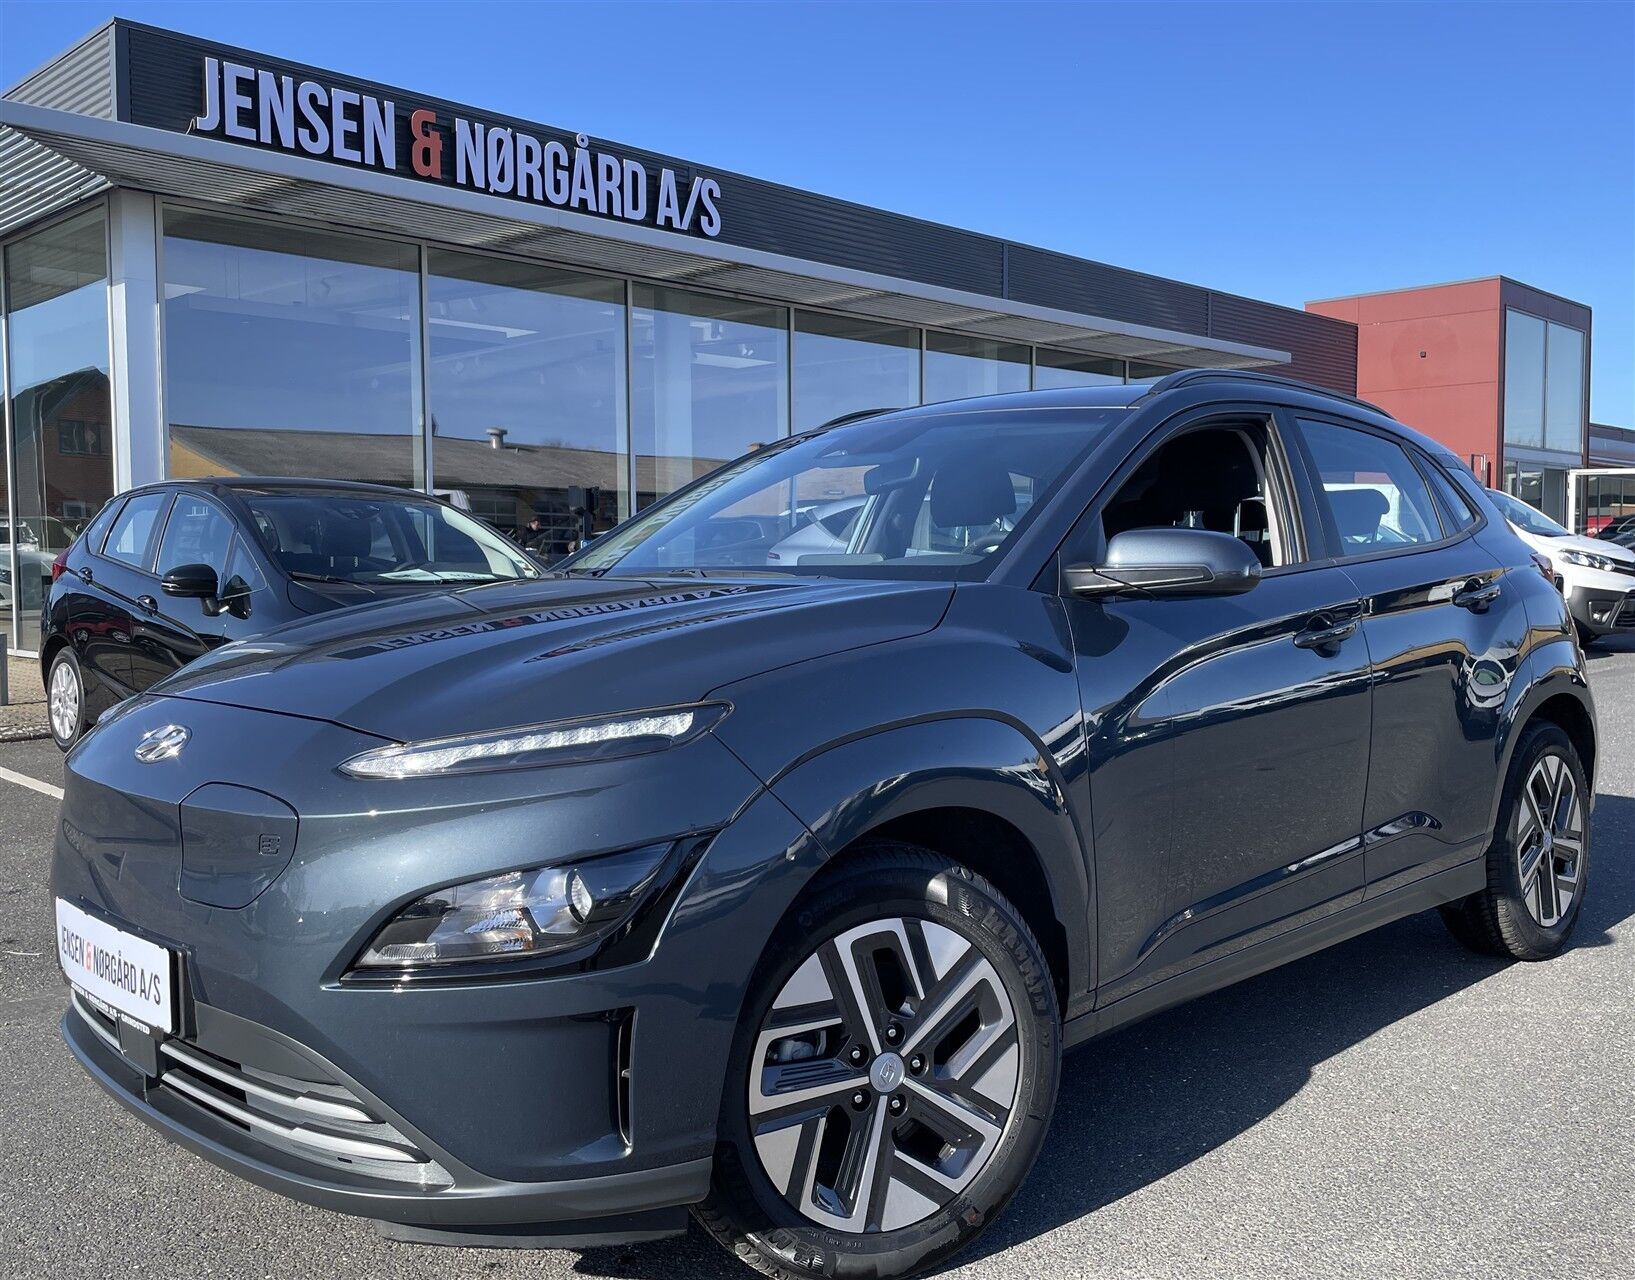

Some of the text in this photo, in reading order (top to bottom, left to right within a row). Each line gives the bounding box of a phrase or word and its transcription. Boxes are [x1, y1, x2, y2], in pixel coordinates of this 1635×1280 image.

[197, 56, 722, 236] JENSEN & NØRGÅRD A/S
[62, 926, 84, 967] JENSEN
[85, 941, 92, 971] &
[93, 945, 137, 994] NØRGÅRD
[139, 968, 161, 1006] A/S
